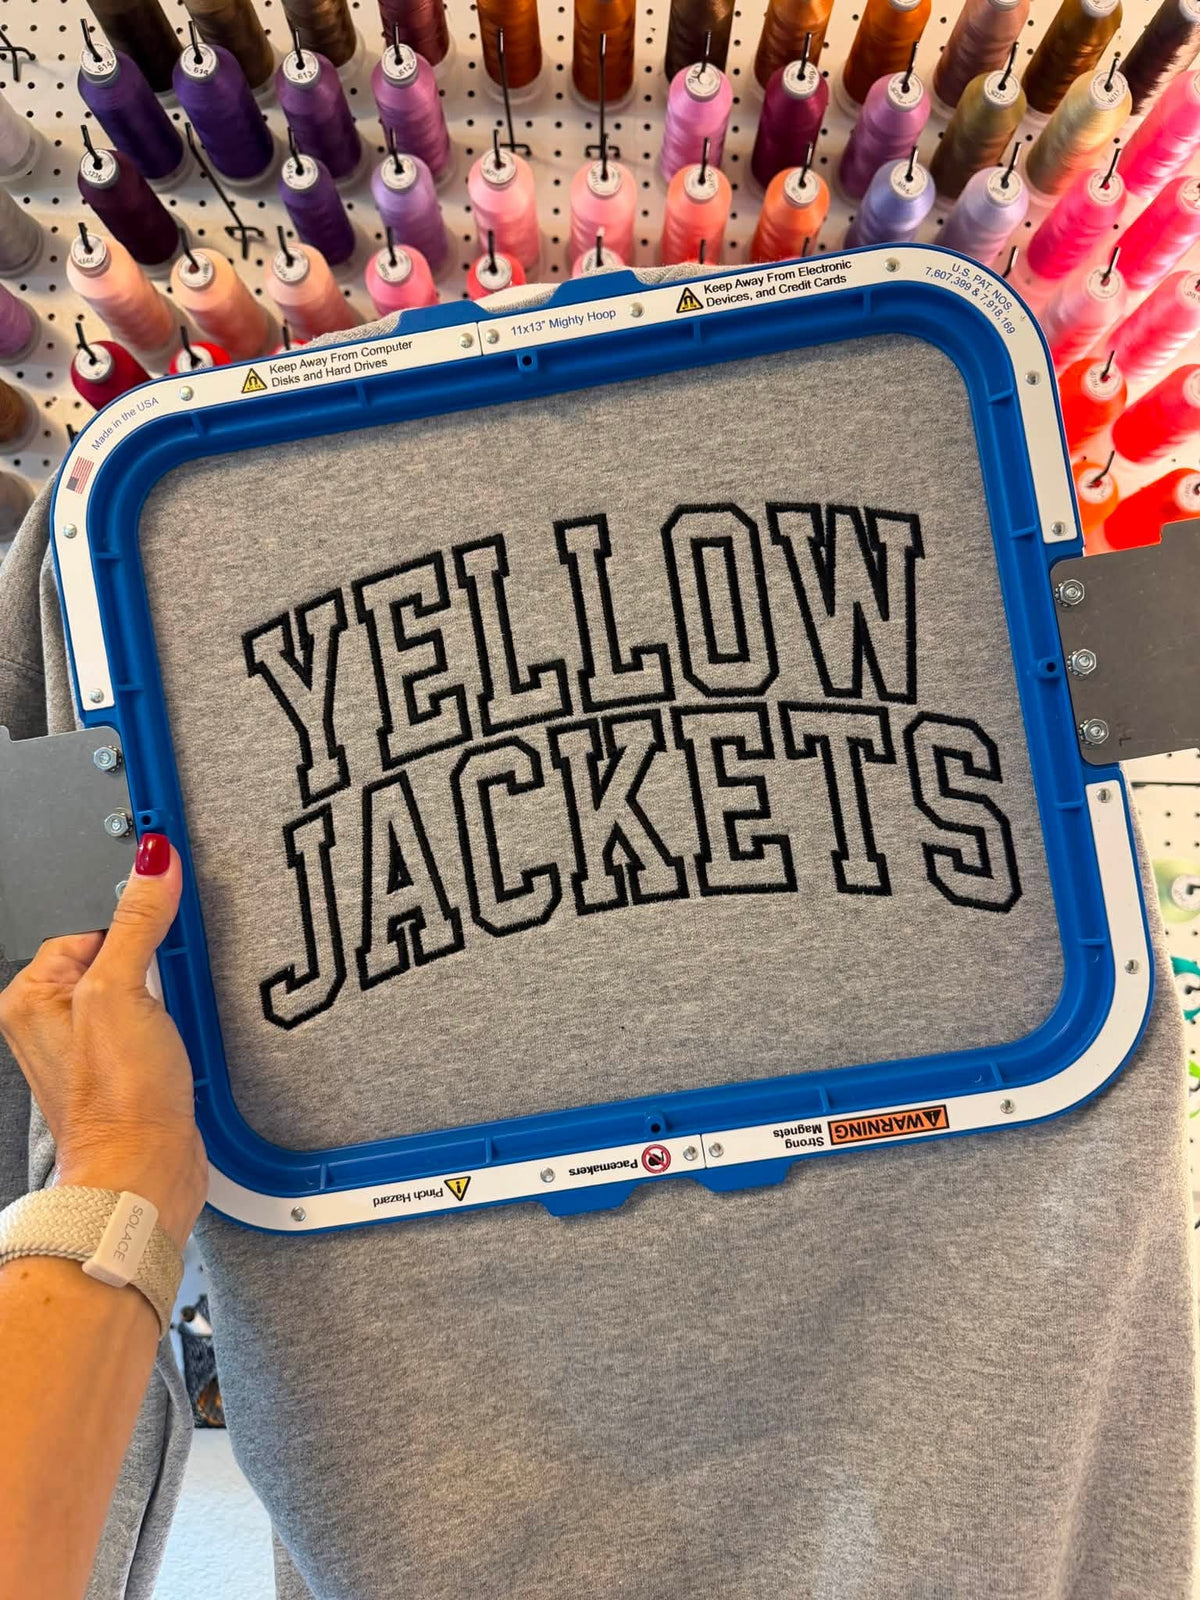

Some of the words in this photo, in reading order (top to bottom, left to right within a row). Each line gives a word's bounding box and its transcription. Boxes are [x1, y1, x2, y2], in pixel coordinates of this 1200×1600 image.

[704, 281, 733, 295] Keep
[735, 275, 765, 290] Away
[767, 270, 796, 283] From
[799, 259, 852, 277] Electronic
[706, 291, 753, 308] Devices,
[755, 285, 777, 299] and
[778, 278, 812, 294] Credit
[814, 274, 848, 288] Cards
[951, 263, 971, 279] U.S.
[973, 274, 993, 293] PAT.
[992, 289, 1013, 313] NOS.
[971, 287, 980, 297] &
[549, 315, 584, 329] Mighty
[587, 309, 617, 322] Hoop
[269, 363, 298, 375] Keep
[299, 357, 328, 369] Away
[330, 350, 359, 363] From
[361, 340, 413, 358] Computer
[271, 374, 301, 388] Disks
[303, 369, 323, 382] and
[325, 364, 352, 378] Hard
[354, 358, 388, 373] Drives
[91, 427, 114, 451] Made
[112, 419, 122, 429] in
[121, 408, 137, 421] the
[136, 396, 160, 412] USA
[241, 502, 925, 804] YELLOW
[260, 701, 1023, 1031] JACKETS
[772, 1123, 823, 1139] Magnets
[834, 1112, 925, 1140] WARNING
[785, 1136, 825, 1149] Strong
[568, 1158, 639, 1176] Pacemakers
[372, 1192, 412, 1208] Hazard
[413, 1187, 444, 1201] Pinch
[113, 1204, 144, 1263] SOLACE
